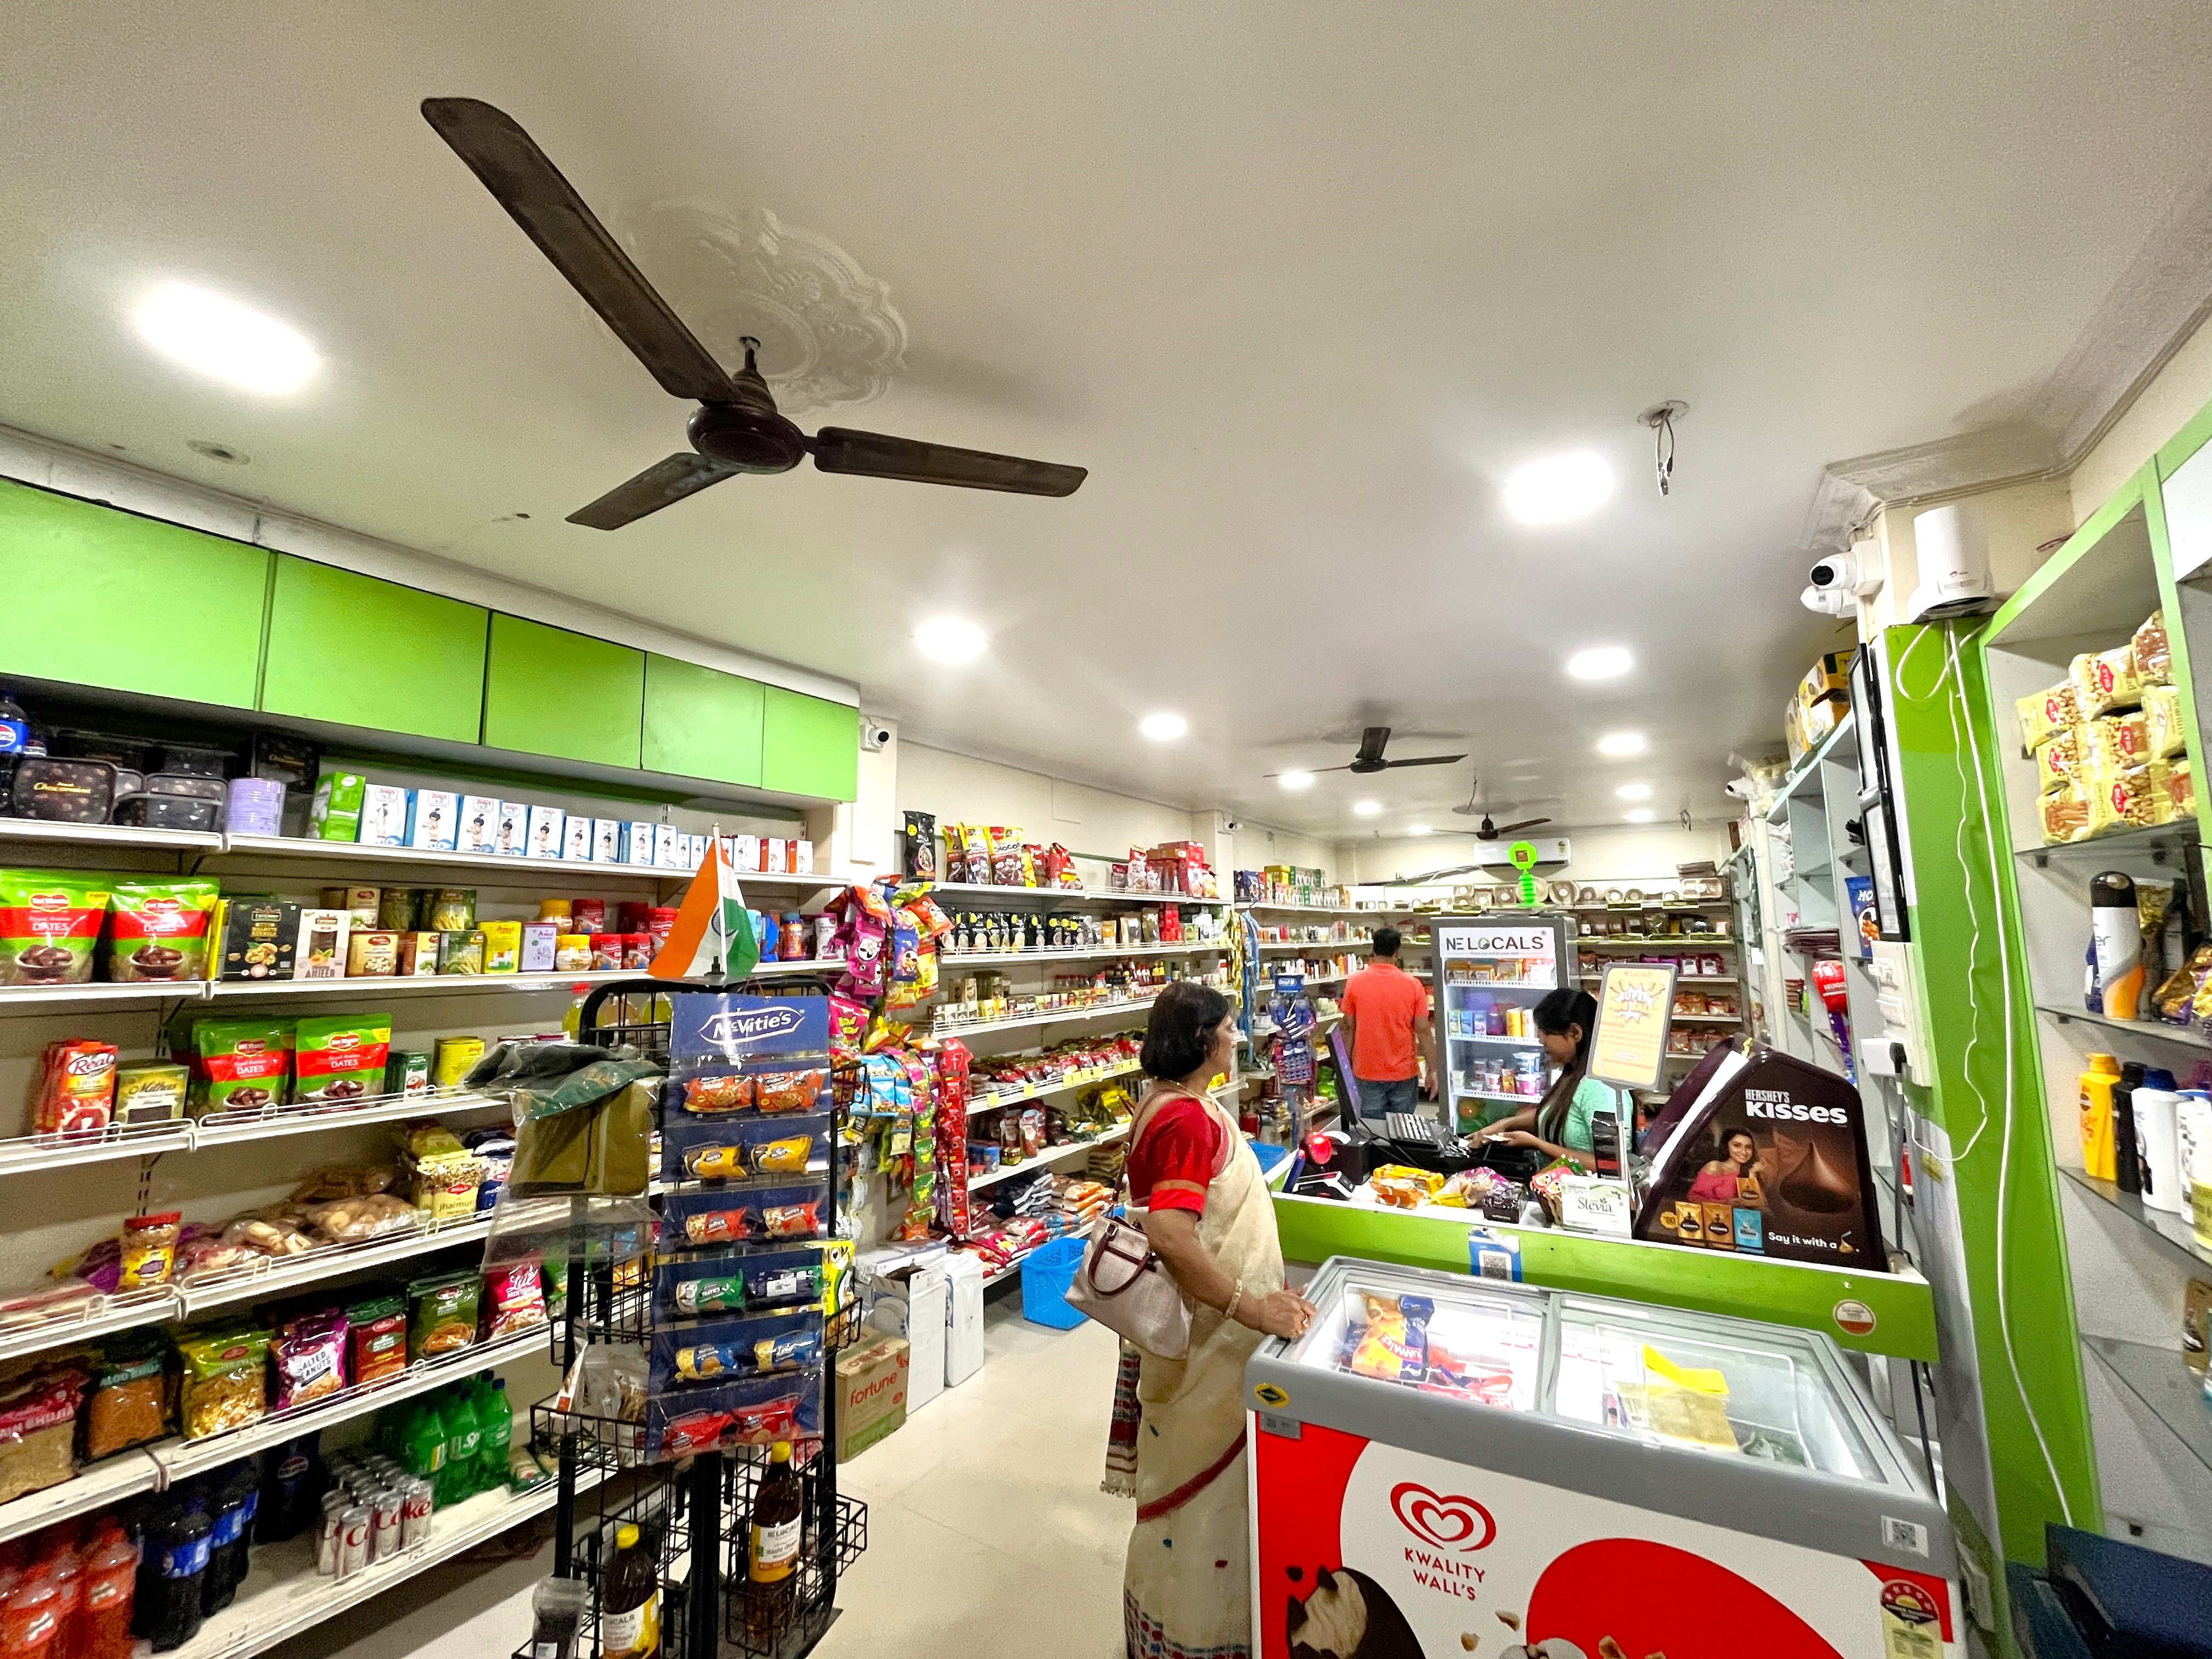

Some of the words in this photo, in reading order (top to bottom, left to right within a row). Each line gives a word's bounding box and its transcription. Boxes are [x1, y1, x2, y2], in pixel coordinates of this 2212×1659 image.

[32, 922, 69, 932] DATES
[1467, 936, 1544, 950] LOCALS
[713, 1011, 792, 1038] McVitie's
[74, 1054, 114, 1074] Real
[236, 1064, 266, 1075] DATES
[330, 1058, 359, 1069] DATES
[1745, 1088, 1790, 1104] HERSHEY'S
[1577, 1196, 1613, 1212] Stevia
[1768, 1231, 1790, 1245] Say
[1792, 1234, 1801, 1244] it
[1802, 1235, 1827, 1248] with
[850, 1372, 899, 1407] fortune
[1404, 1547, 1486, 1583] KWALITY
[1413, 1568, 1476, 1601] WALL'S
